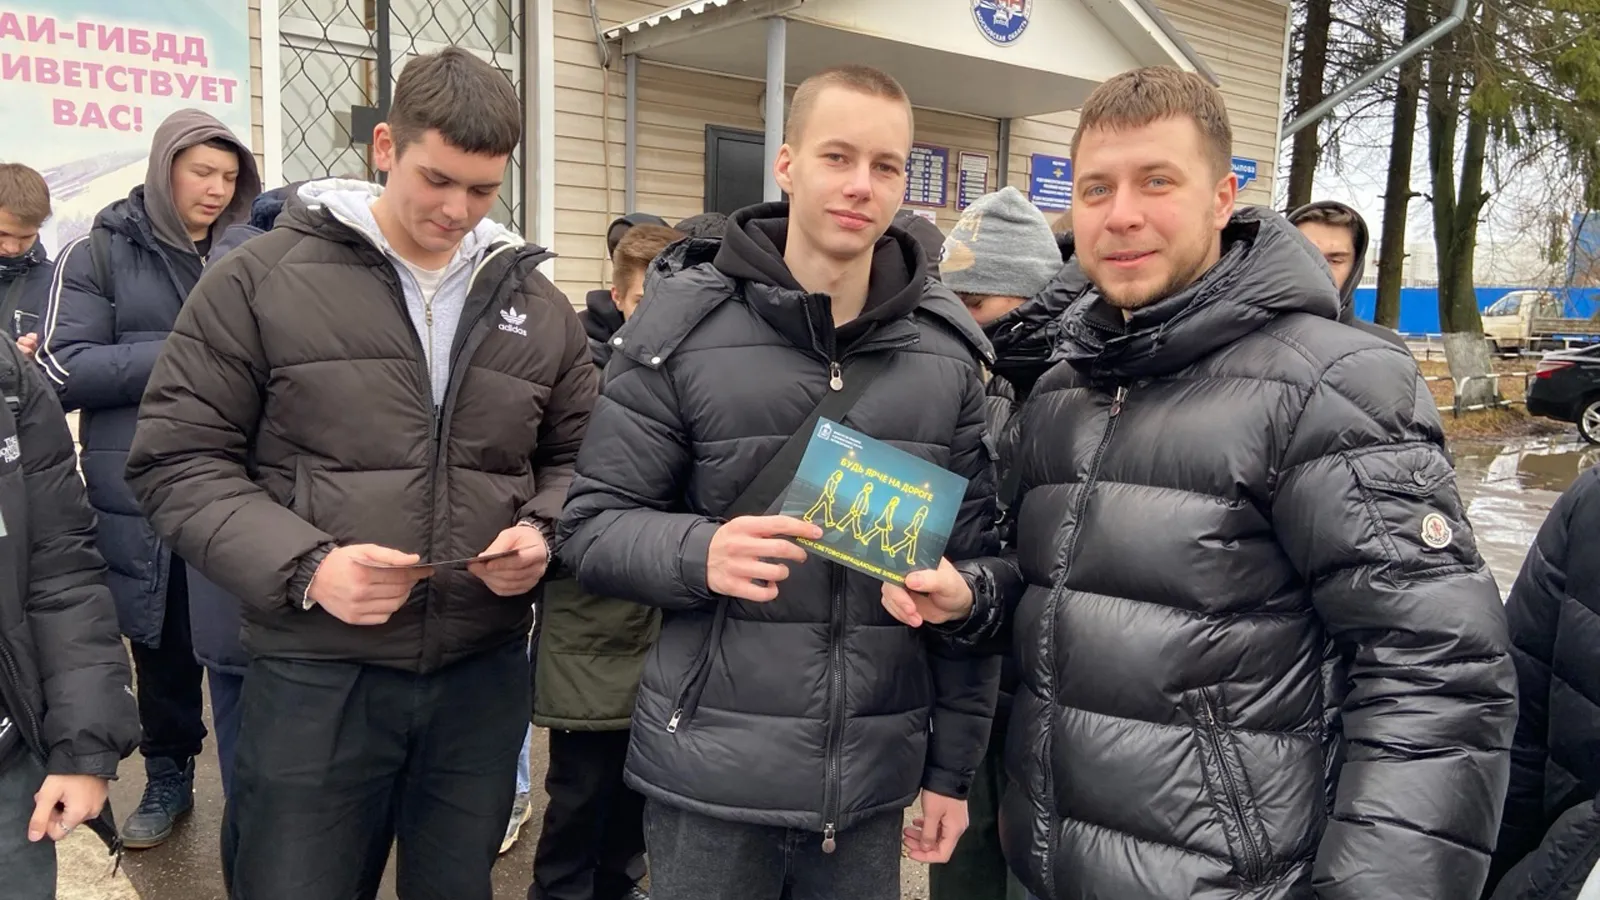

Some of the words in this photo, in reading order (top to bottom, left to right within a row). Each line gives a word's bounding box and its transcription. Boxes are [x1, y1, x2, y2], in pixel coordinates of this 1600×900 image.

[0, 12, 208, 68] АИ-ГИБДД
[1, 53, 237, 103] ИВЕТСТВУЕТ
[52, 98, 143, 132] ВАС!
[498, 324, 527, 337] adidas
[840, 458, 864, 473] БУДЬ
[865, 468, 888, 484] ЯРЧЕ
[888, 477, 901, 488] НА
[901, 483, 934, 502] ДОРОГЕ
[882, 570, 906, 583] ЭЛЕМЕН
